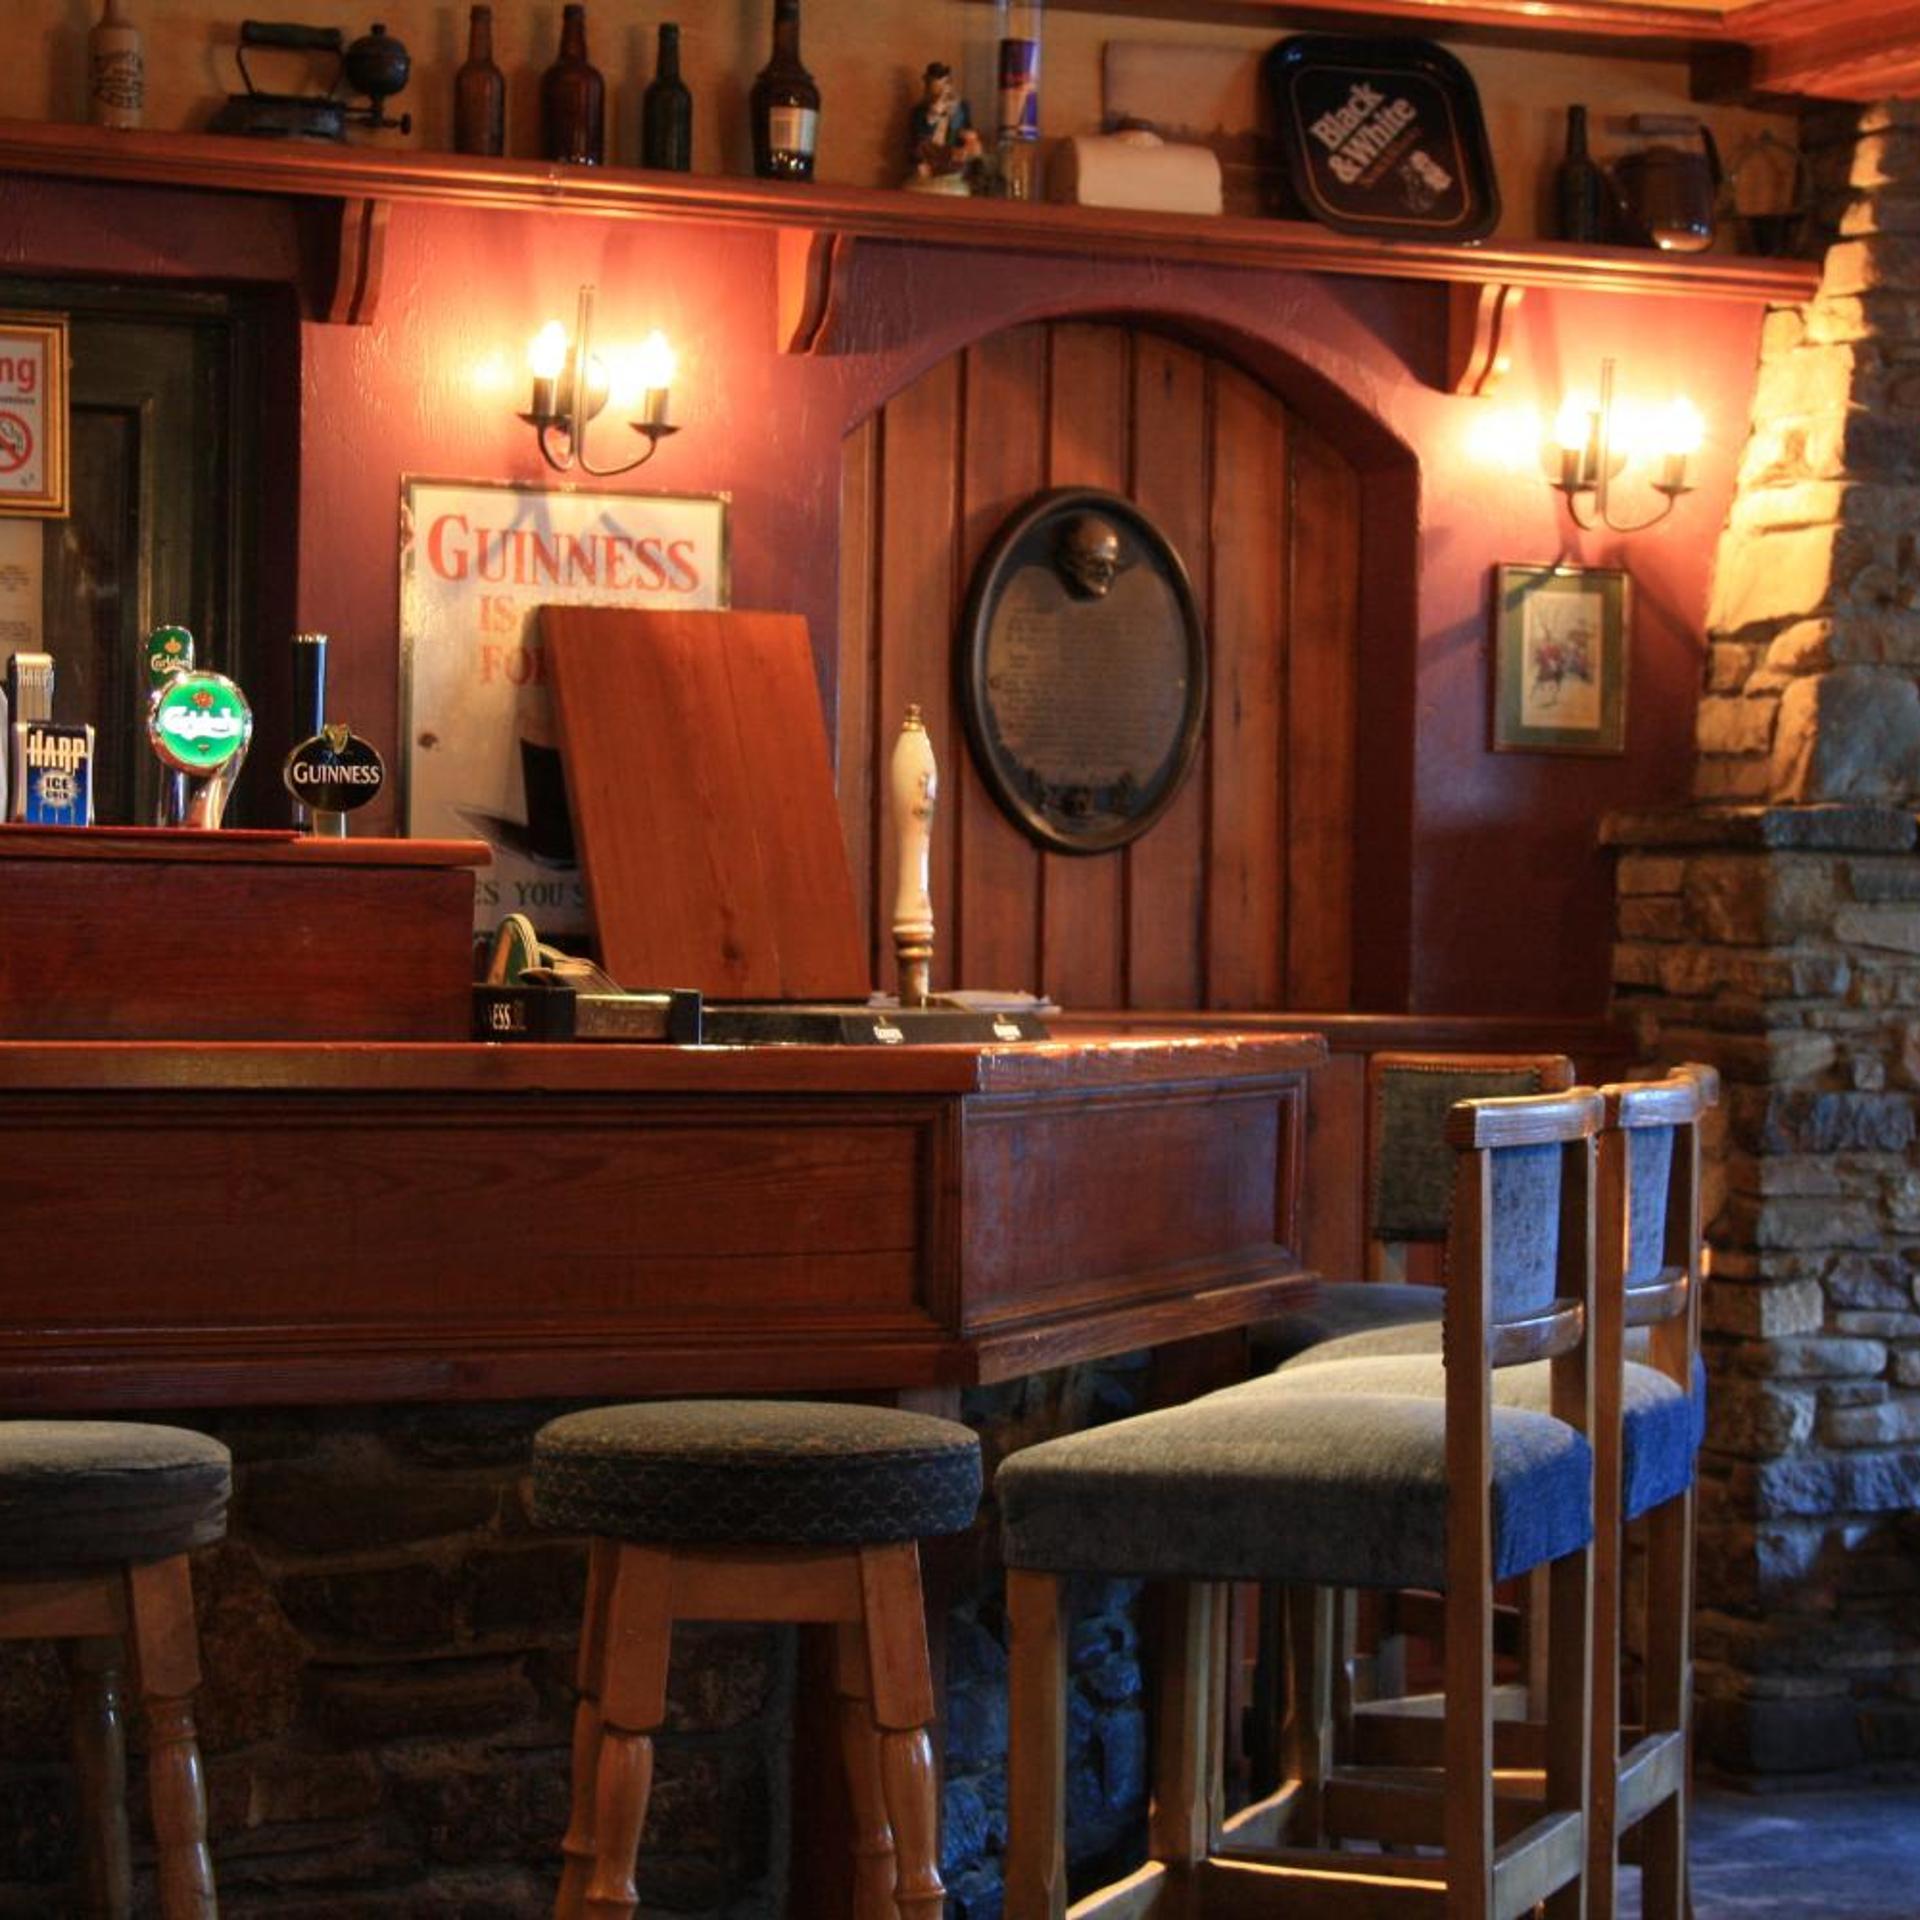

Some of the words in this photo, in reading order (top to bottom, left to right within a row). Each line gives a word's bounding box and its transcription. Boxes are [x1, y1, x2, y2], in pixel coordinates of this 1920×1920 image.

[1310, 83, 1383, 150] Black
[427, 513, 700, 593] GUINNESS
[478, 595, 516, 632] IS
[28, 730, 86, 773] HARP
[46, 776, 70, 790] ICE
[293, 762, 380, 784] GUINNESS
[515, 881, 564, 906] YOU
